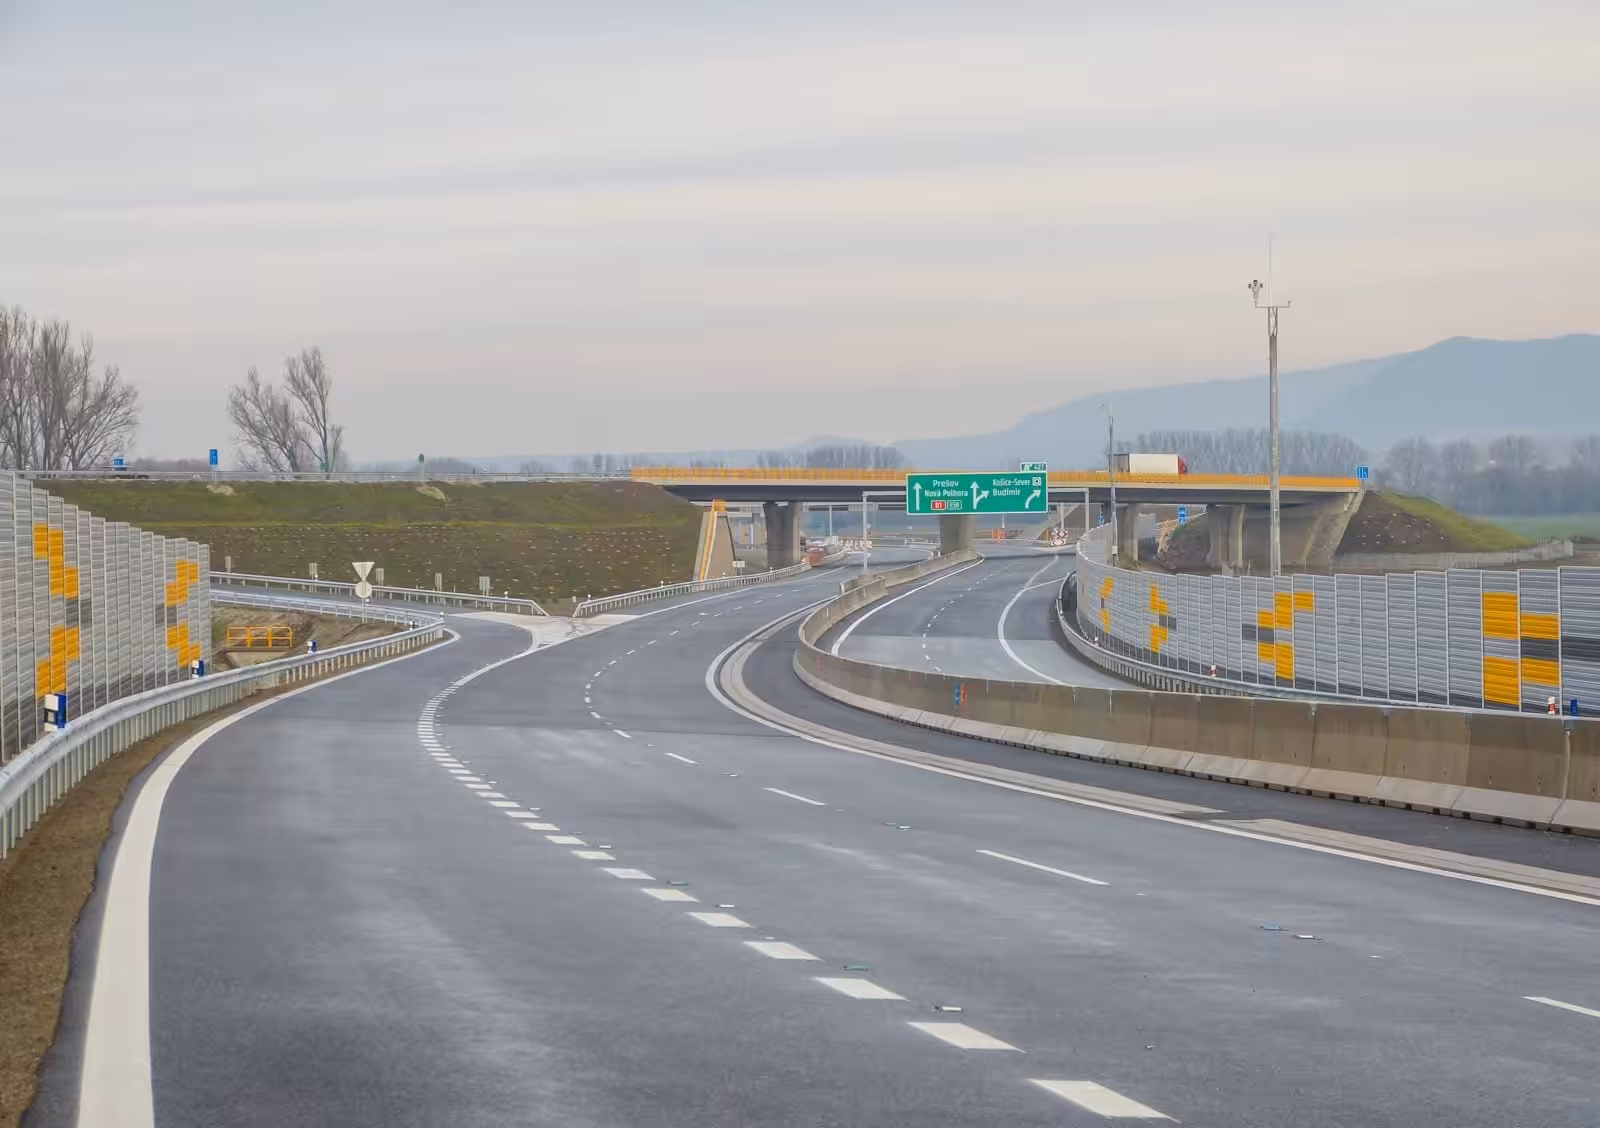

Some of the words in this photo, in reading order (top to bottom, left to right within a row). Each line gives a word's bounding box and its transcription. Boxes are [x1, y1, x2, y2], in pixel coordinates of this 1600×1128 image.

[932, 479, 959, 488] Prešov
[992, 478, 1031, 487] Košice-Sever
[924, 489, 941, 497] Nová
[992, 488, 1021, 497] Budimir
[934, 501, 943, 509] D1
